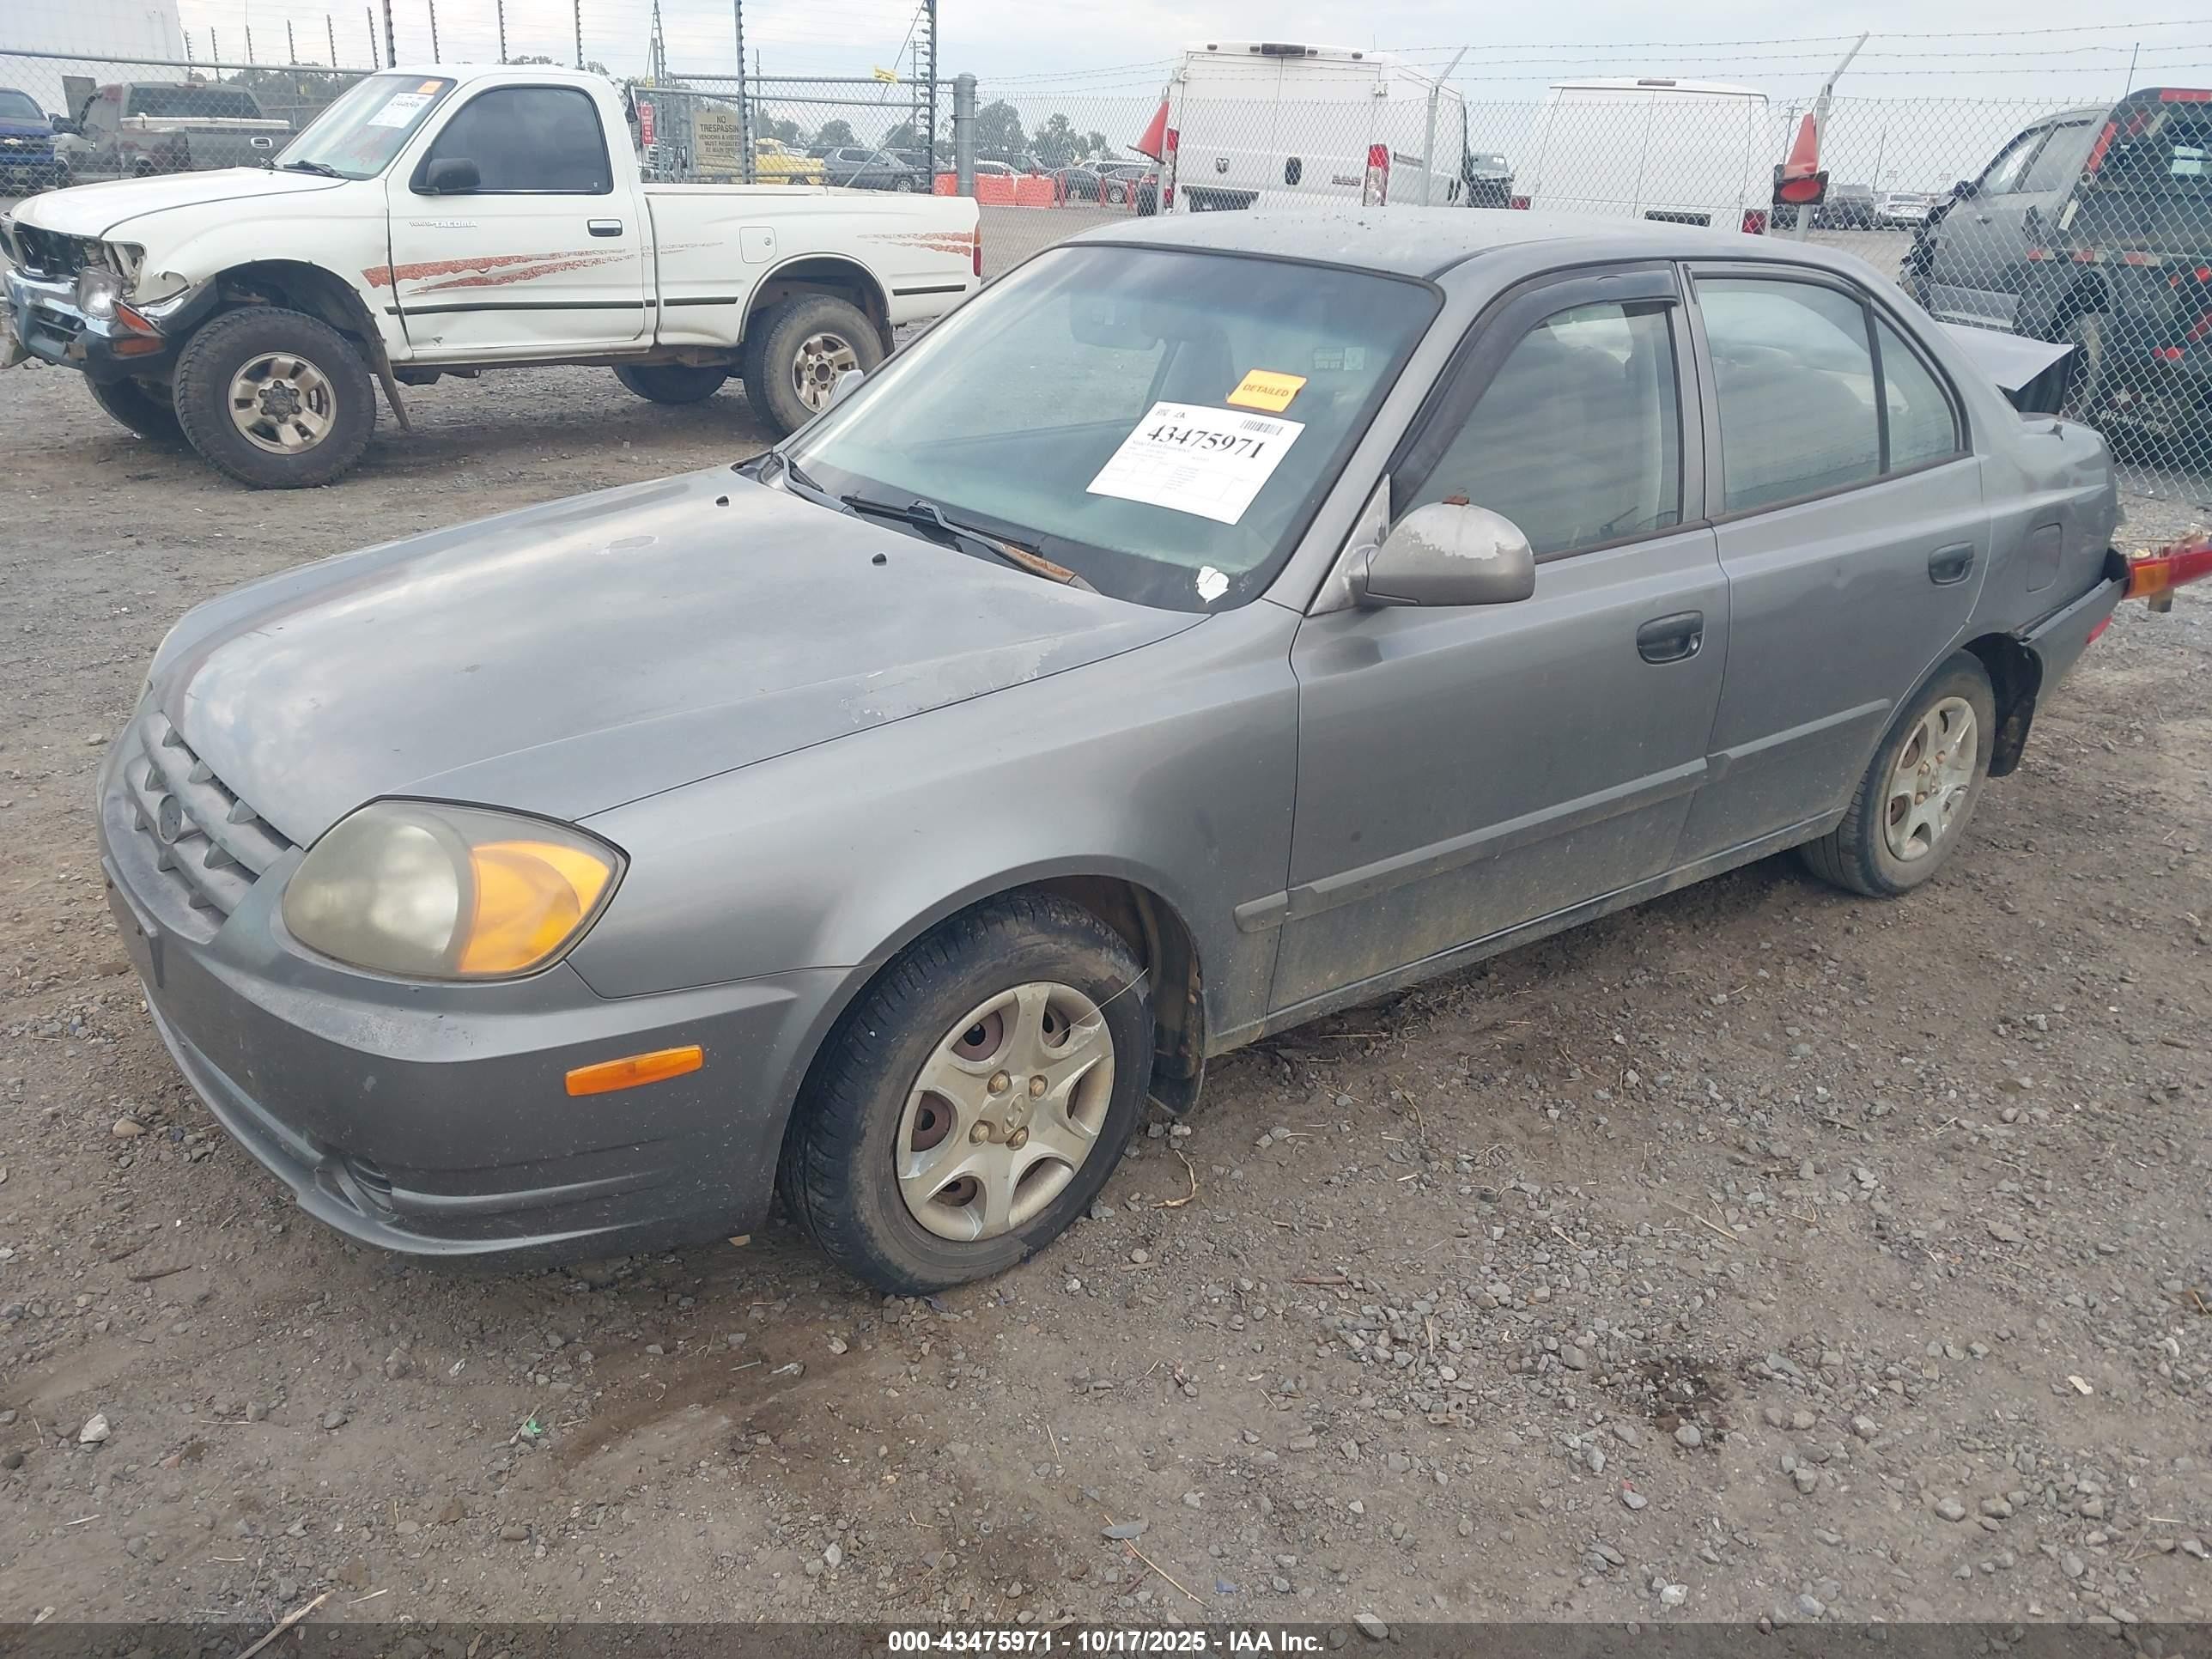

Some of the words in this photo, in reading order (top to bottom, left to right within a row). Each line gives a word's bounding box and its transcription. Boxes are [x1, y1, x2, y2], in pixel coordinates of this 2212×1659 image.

[716, 114, 726, 124] NO
[700, 124, 739, 133] TRESPASSIN
[433, 220, 477, 228] TACOMA
[1243, 383, 1290, 398] DETAILED
[1147, 424, 1267, 459] 43475971
